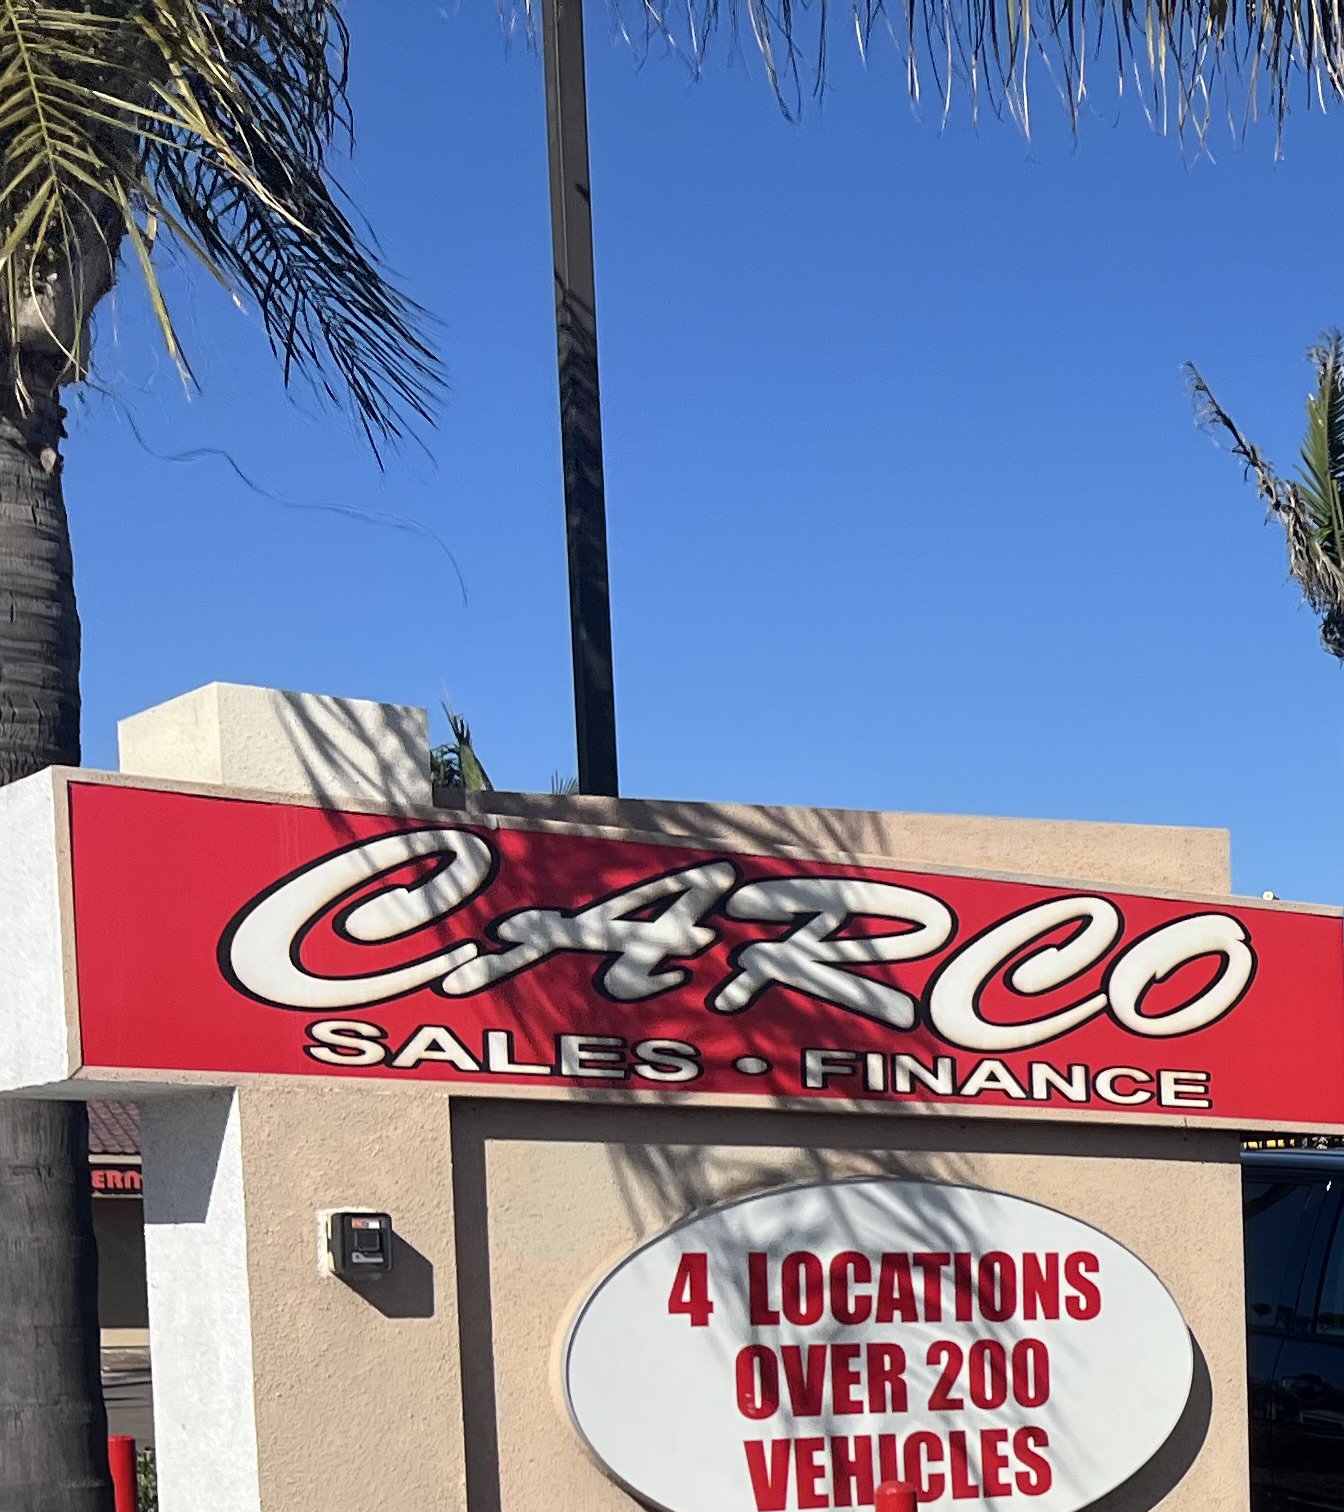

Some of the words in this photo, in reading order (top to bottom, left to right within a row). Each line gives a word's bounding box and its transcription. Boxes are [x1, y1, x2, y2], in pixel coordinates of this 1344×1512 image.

[217, 826, 1257, 1052] CARCO
[303, 1019, 701, 1083] SALES
[802, 1048, 1213, 1109] FINANCE
[668, 1252, 714, 1328] 4
[748, 1250, 1101, 1326] LOCATIONS
[735, 1340, 908, 1420] OVER
[926, 1338, 1050, 1412] 200
[744, 1426, 1052, 1512] VEHICLES
